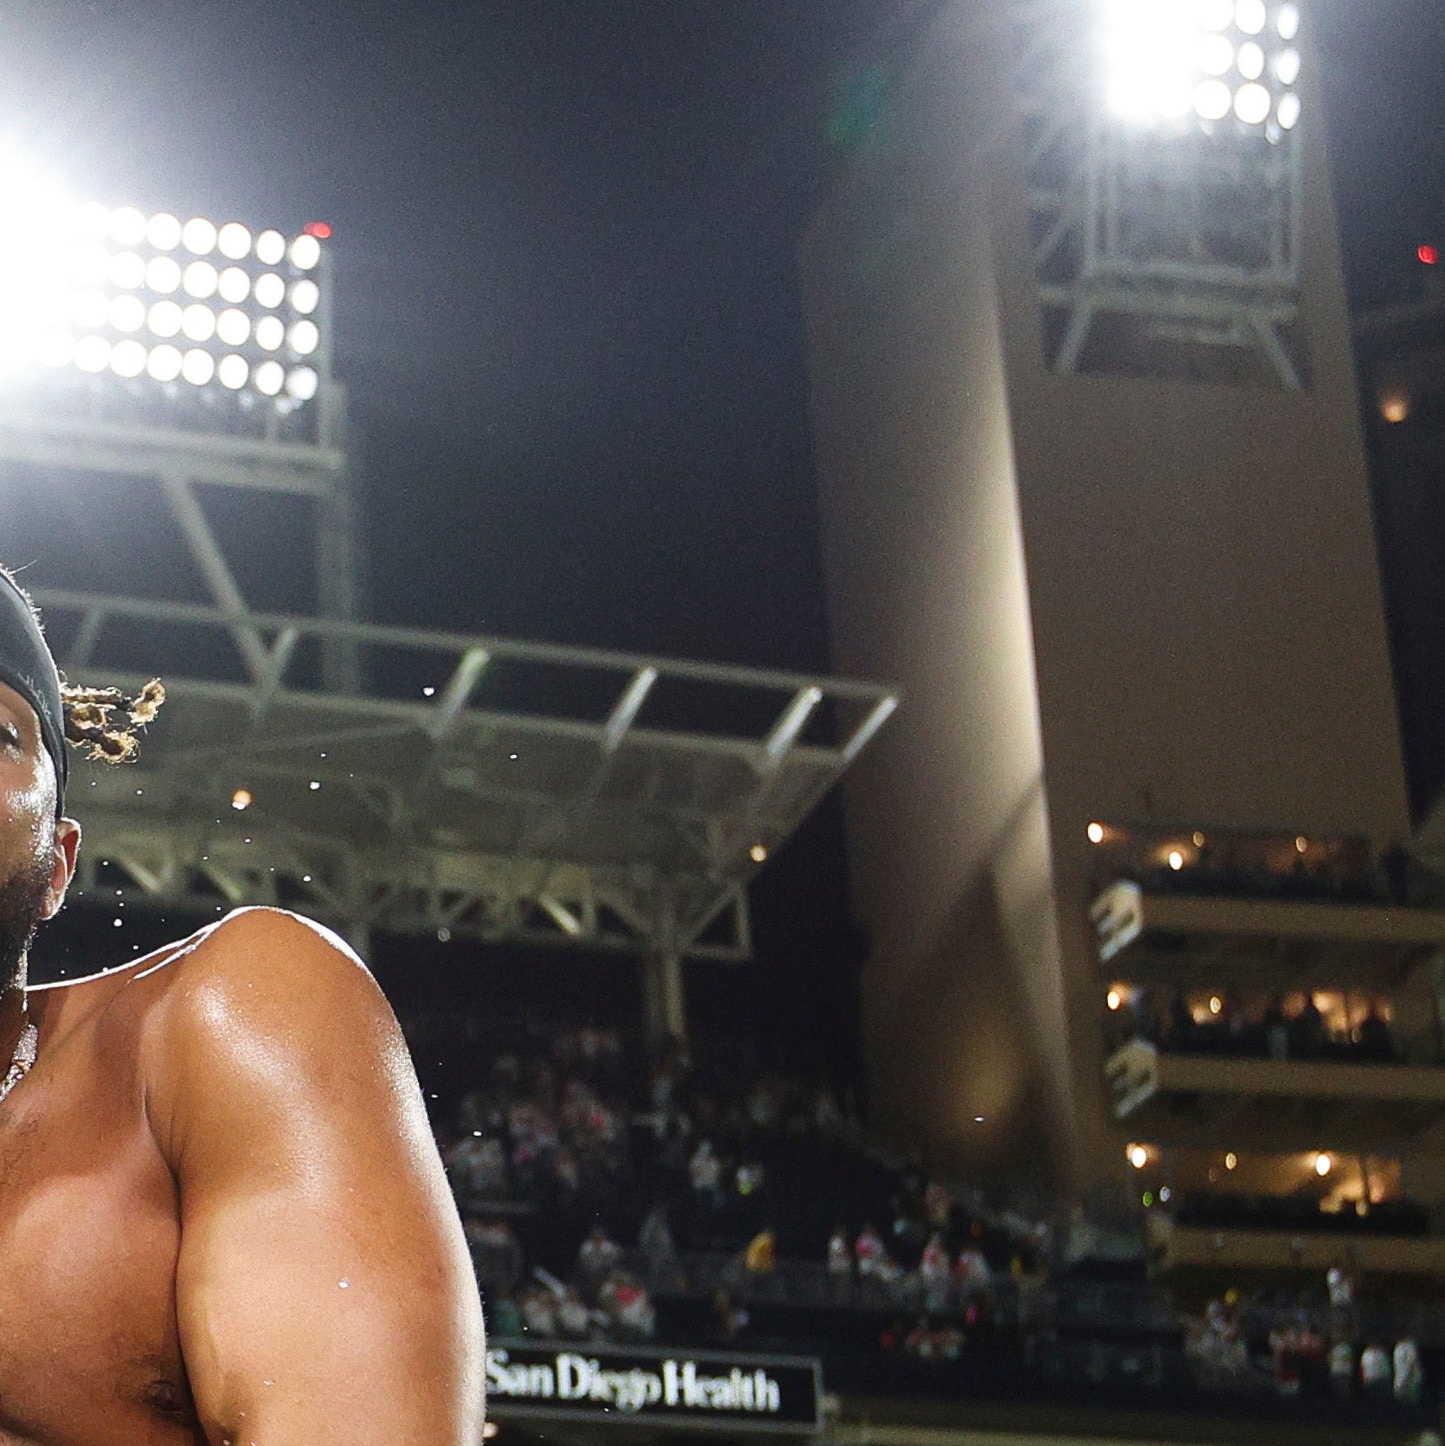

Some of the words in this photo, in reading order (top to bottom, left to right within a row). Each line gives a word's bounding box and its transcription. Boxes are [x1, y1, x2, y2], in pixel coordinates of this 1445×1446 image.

[486, 1350, 555, 1398] San
[556, 1353, 662, 1413] Diego
[663, 1359, 781, 1412] Health
